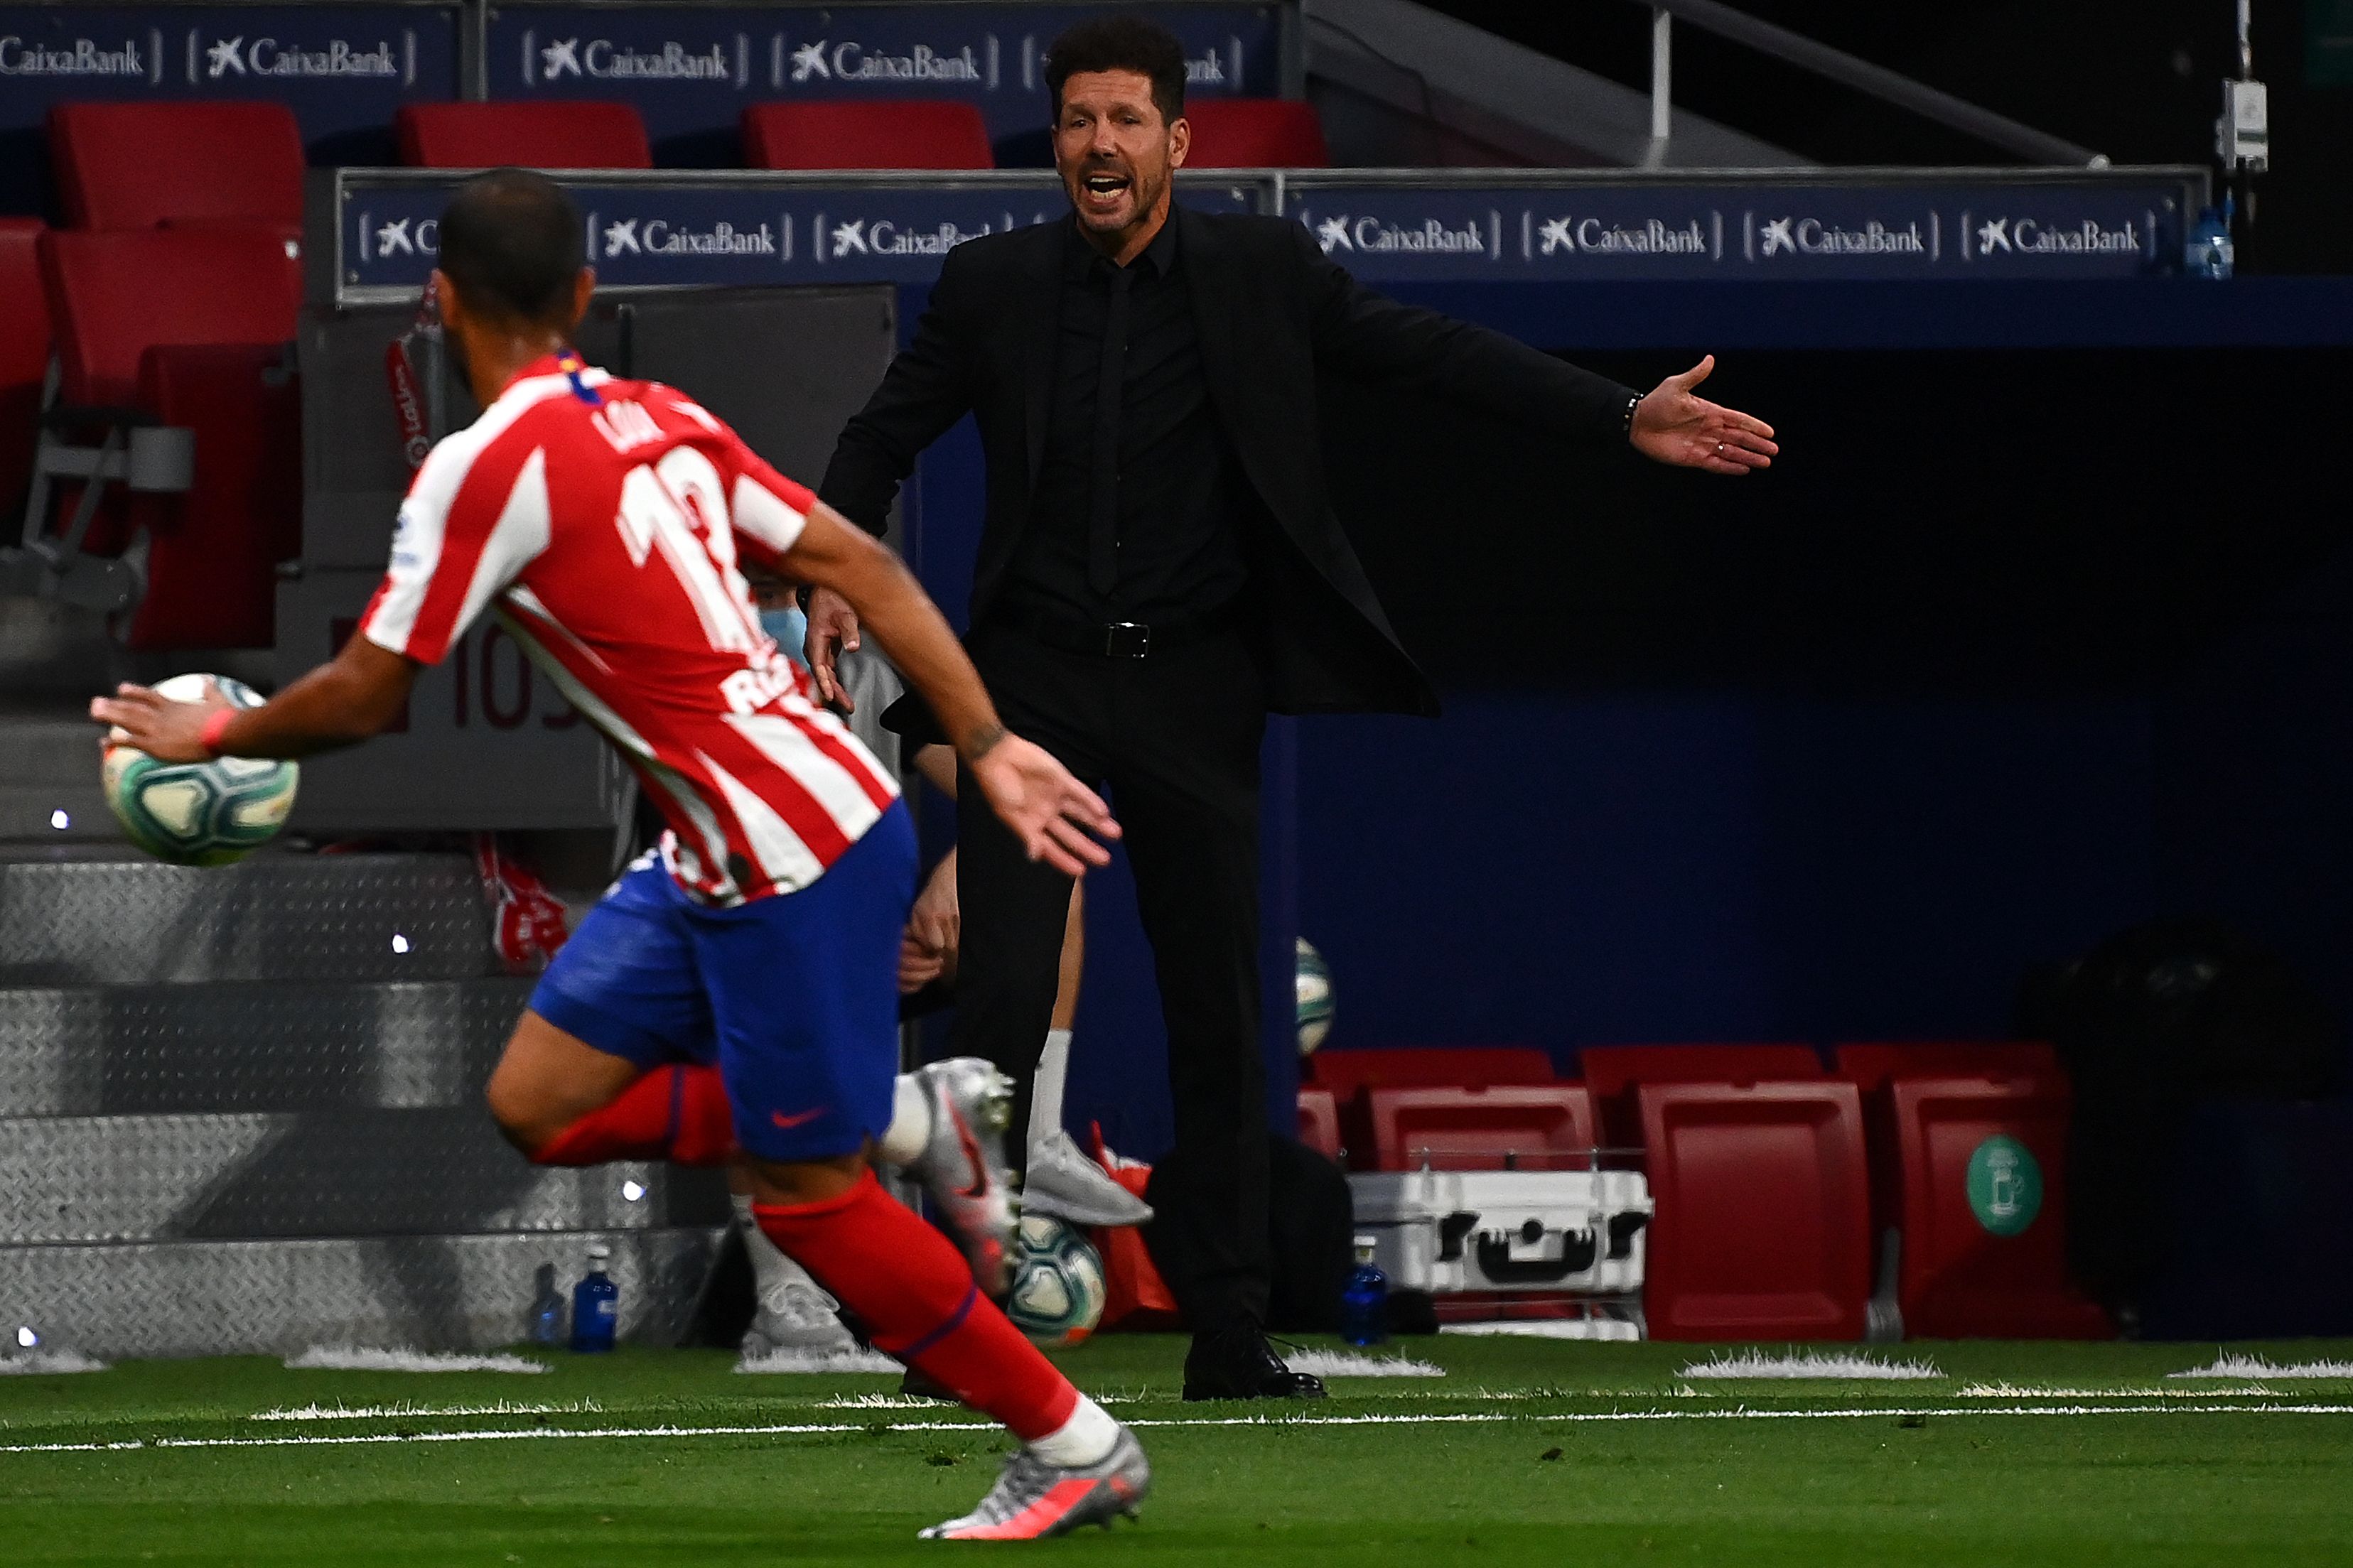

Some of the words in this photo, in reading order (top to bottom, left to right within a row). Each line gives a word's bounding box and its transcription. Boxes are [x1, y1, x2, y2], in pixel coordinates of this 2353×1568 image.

[0, 36, 143, 75] CaixaBank
[249, 38, 397, 75] CaixaBank
[584, 40, 729, 79] CaixaBank
[834, 40, 980, 80] CaixaBank
[643, 220, 775, 254] CaixaBank
[870, 220, 991, 254] CaixaB
[1355, 217, 1485, 252] CaixaBank
[1578, 218, 1706, 253] CaixaBank
[1797, 218, 1924, 253] CaixaBank
[2014, 219, 2140, 252] CaixaBank
[456, 624, 580, 728] 10
